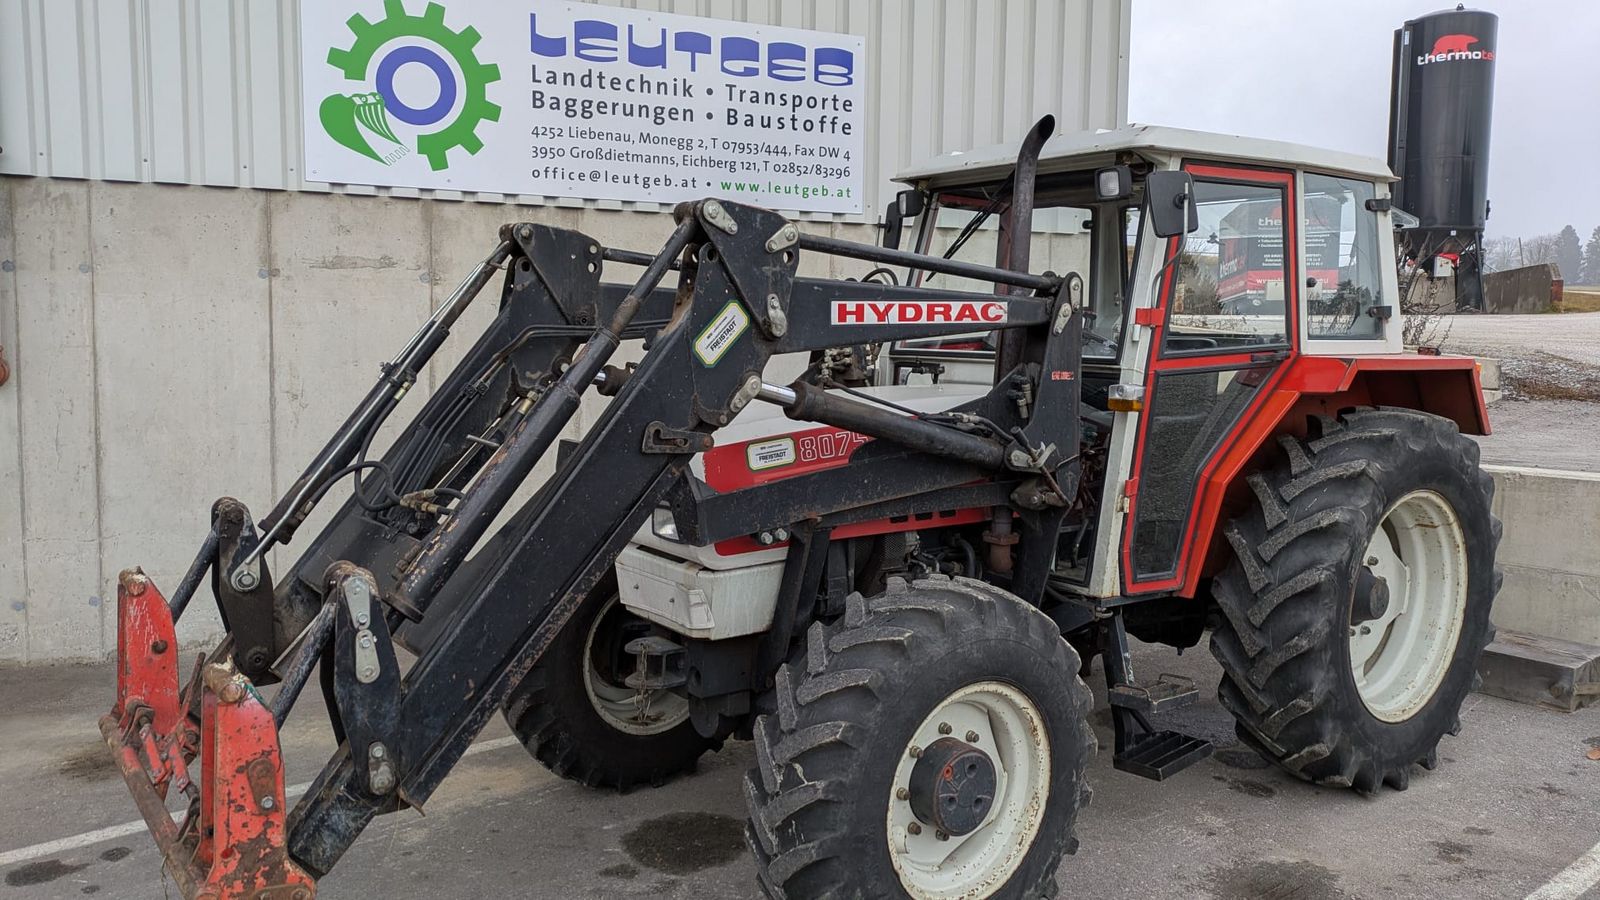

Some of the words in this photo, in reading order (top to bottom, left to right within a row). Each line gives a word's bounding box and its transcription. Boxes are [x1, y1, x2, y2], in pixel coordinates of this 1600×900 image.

[530, 12, 854, 87] LEUTGEB
[1417, 49, 1495, 66] thermote
[531, 64, 694, 98] Landtechnik
[725, 83, 853, 113] Transporte
[531, 90, 694, 126] Baggerungen
[726, 108, 852, 135] Baustoffe
[531, 125, 564, 140] 4252
[568, 126, 635, 145] Liebenau,
[638, 131, 694, 151] Monegg
[697, 139, 708, 151] 2,
[710, 137, 719, 149] T
[722, 140, 792, 157] 07953/444,
[795, 144, 815, 157] Fax
[818, 146, 840, 158] DW
[843, 150, 851, 162] 4
[531, 145, 566, 160] 3950
[569, 146, 679, 168] Großdietmanns,
[682, 154, 737, 173] Eichberg
[740, 161, 761, 174] 121,
[762, 160, 770, 172] T
[773, 162, 851, 179] 02852/83296
[531, 166, 697, 189] office@leutgeb.at
[720, 181, 851, 199] www.leutgeb.at
[837, 302, 1004, 323] HYDRAC
[709, 320, 737, 352] FREISTADT
[758, 450, 787, 462] FREISTADT
